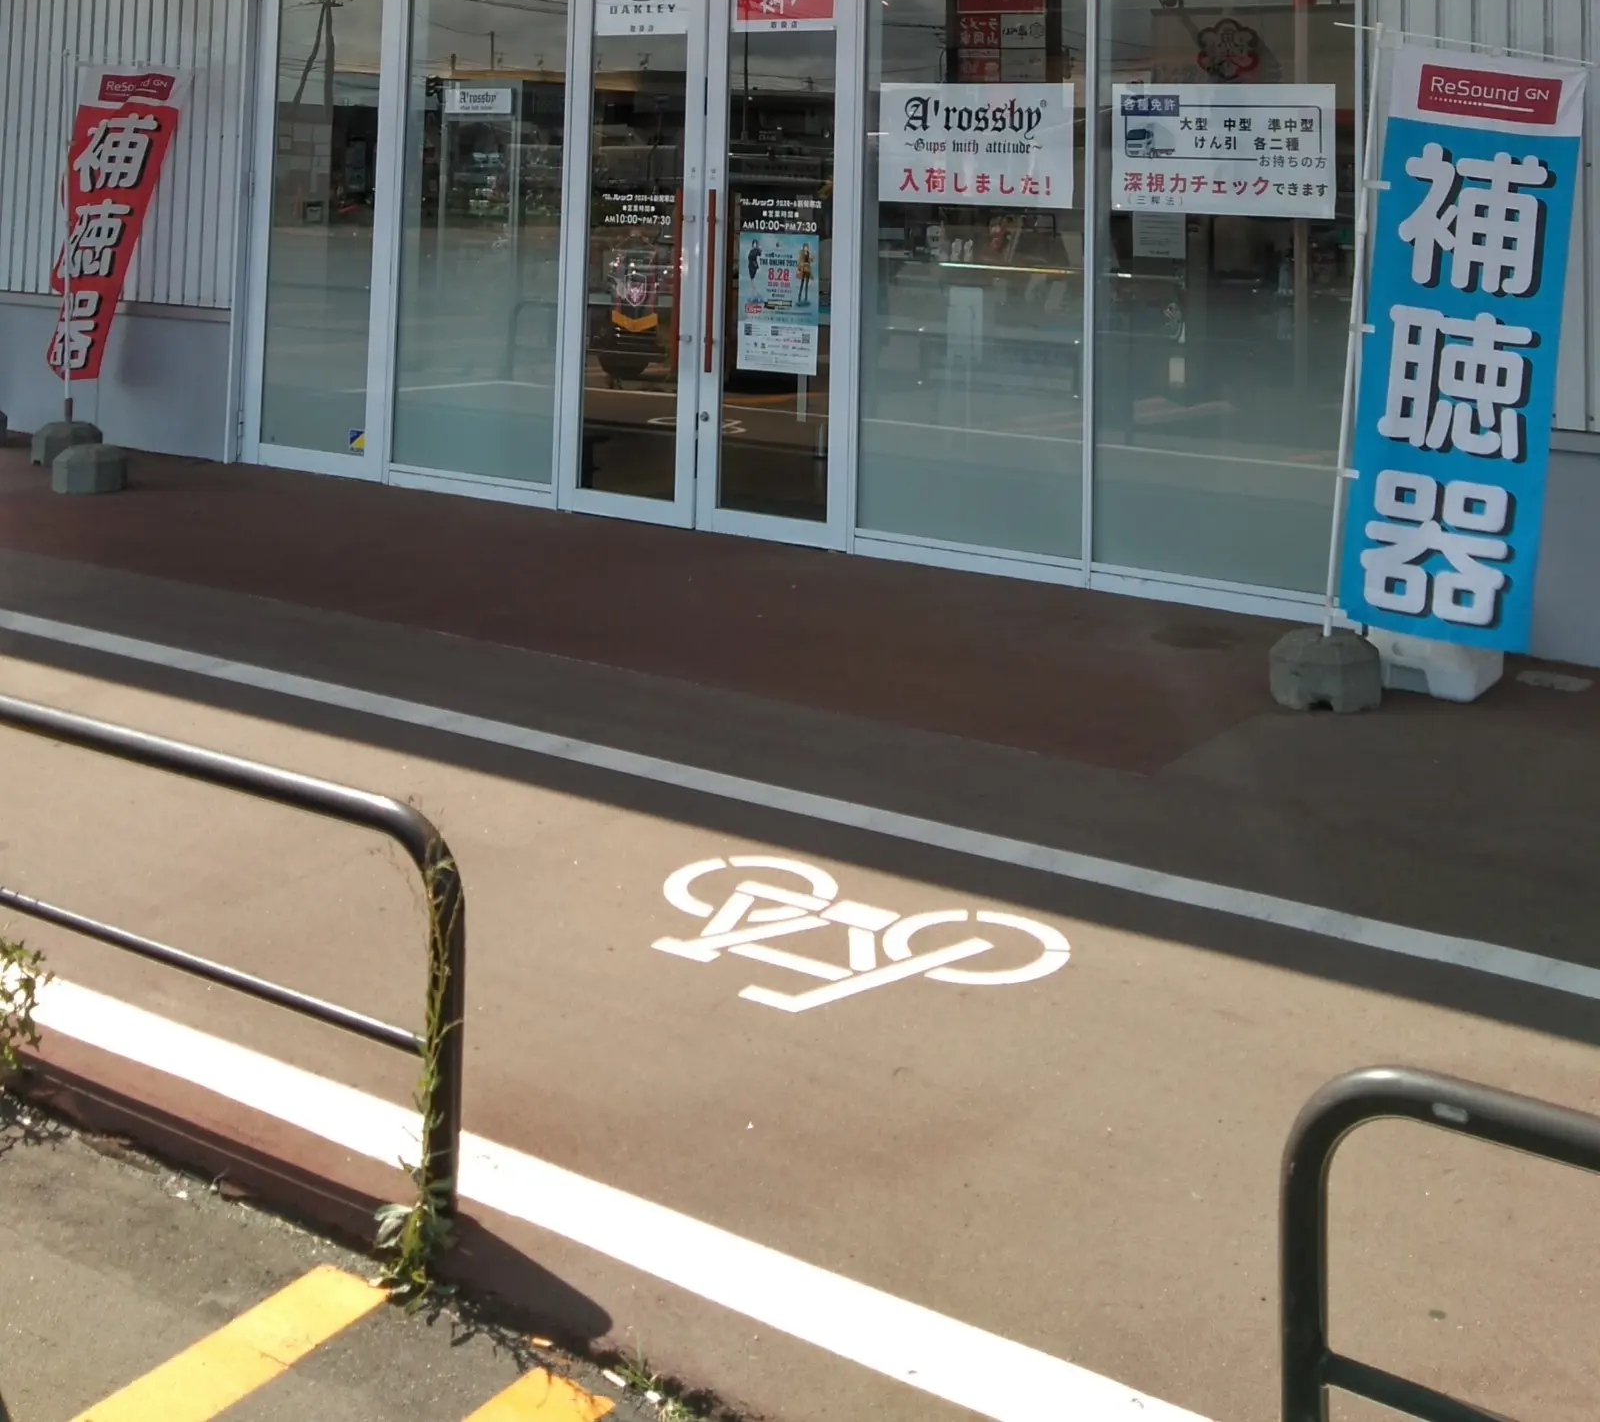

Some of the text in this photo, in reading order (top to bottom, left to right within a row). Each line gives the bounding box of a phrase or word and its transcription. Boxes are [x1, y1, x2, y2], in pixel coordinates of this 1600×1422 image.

[609, 3, 676, 15] OAKLEY
[153, 79, 168, 88] GN
[1430, 76, 1550, 102] ReSound GN
[1122, 97, 1177, 113] 各種免許
[1180, 117, 1314, 133] 大型 中型 準中型
[1194, 136, 1300, 152] けん引 各二種
[1259, 155, 1328, 169] お持ちの方
[1361, 142, 1550, 626] 補聴器
